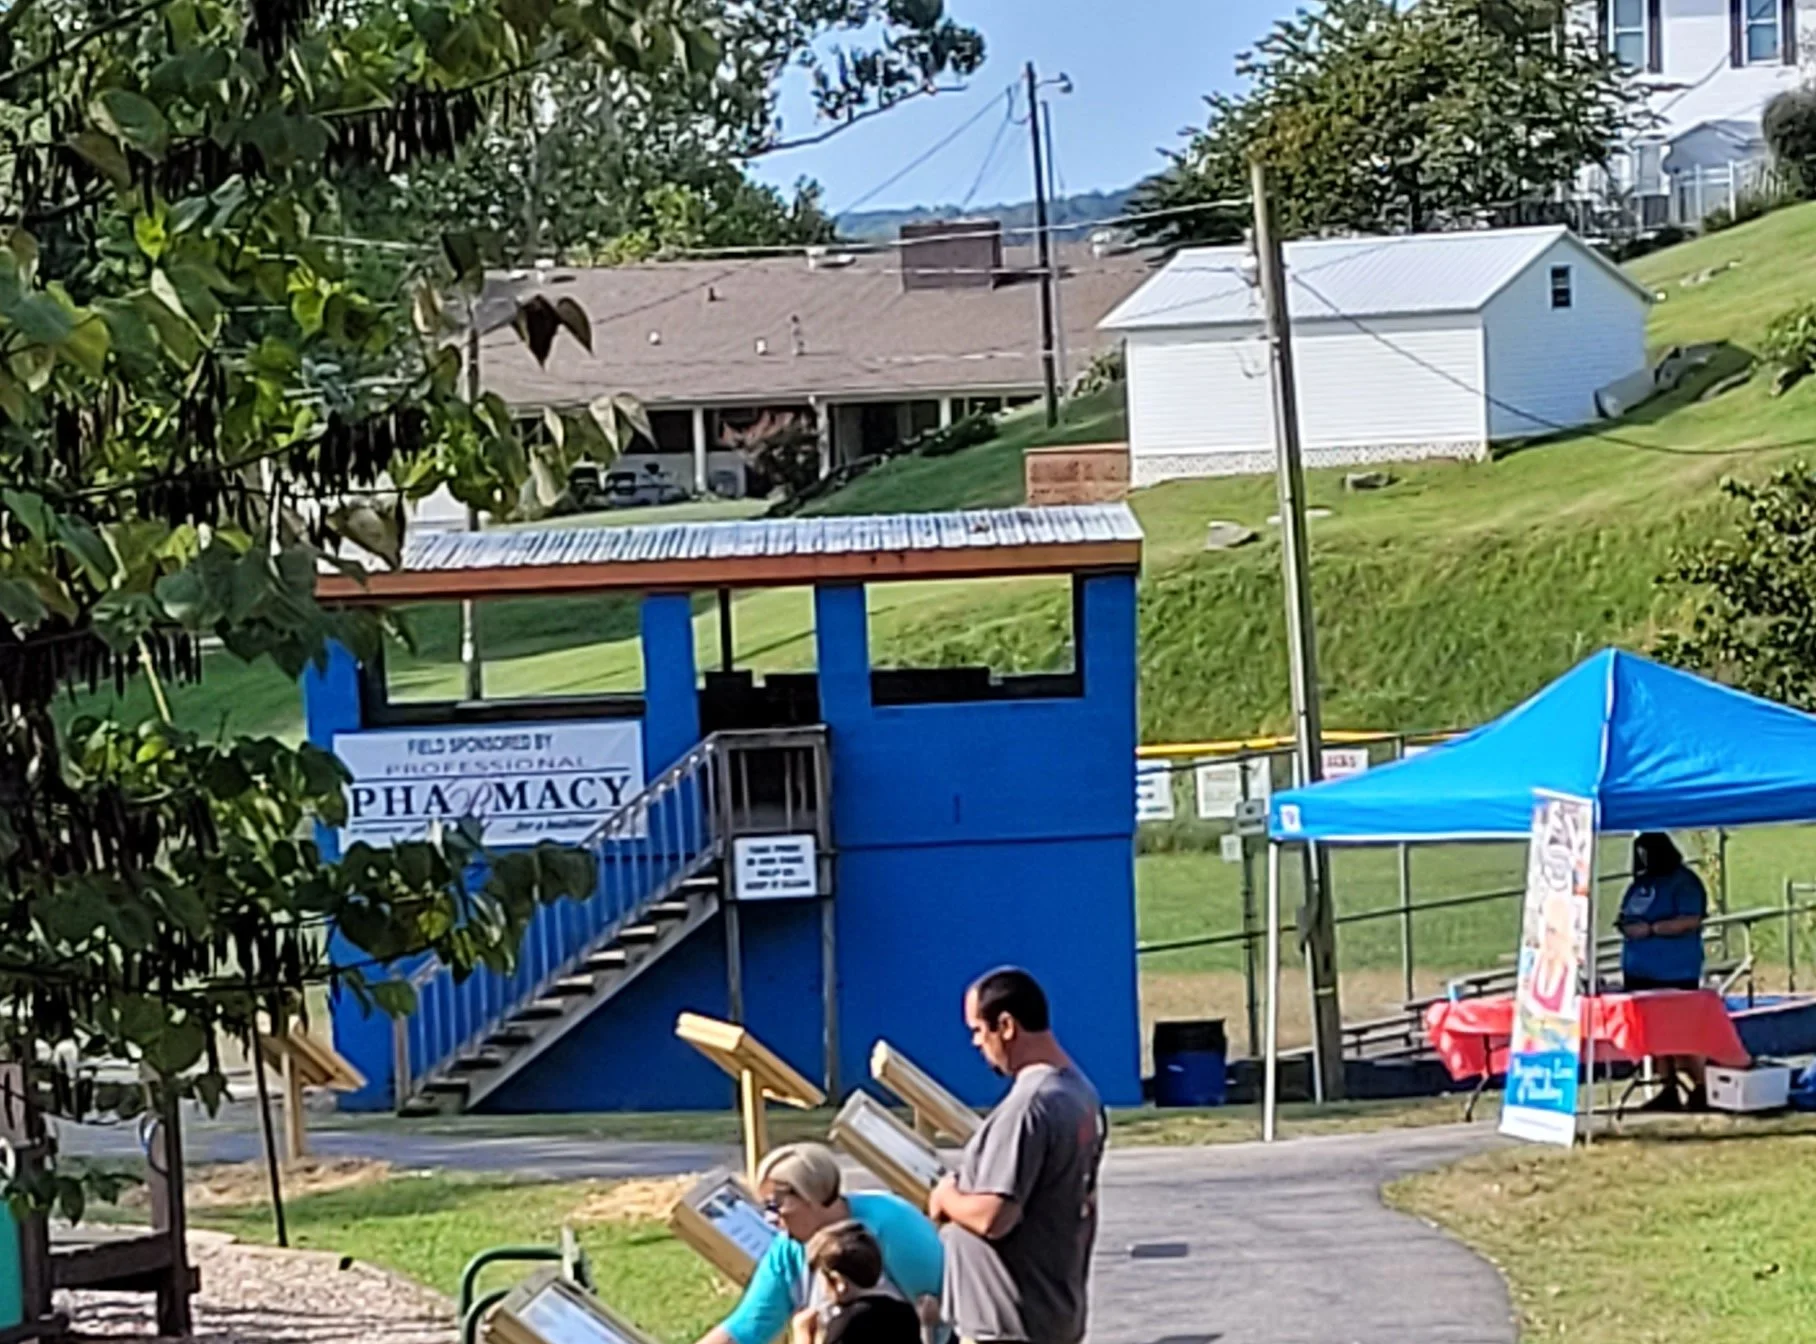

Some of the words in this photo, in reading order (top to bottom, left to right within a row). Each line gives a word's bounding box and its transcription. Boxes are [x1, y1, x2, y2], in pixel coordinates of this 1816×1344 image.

[408, 737, 445, 755] FIELD
[449, 734, 531, 753] SPONSORED
[534, 733, 553, 750] BY
[386, 756, 585, 776] PROFESSIONAL
[351, 775, 630, 818] PHARMACY
